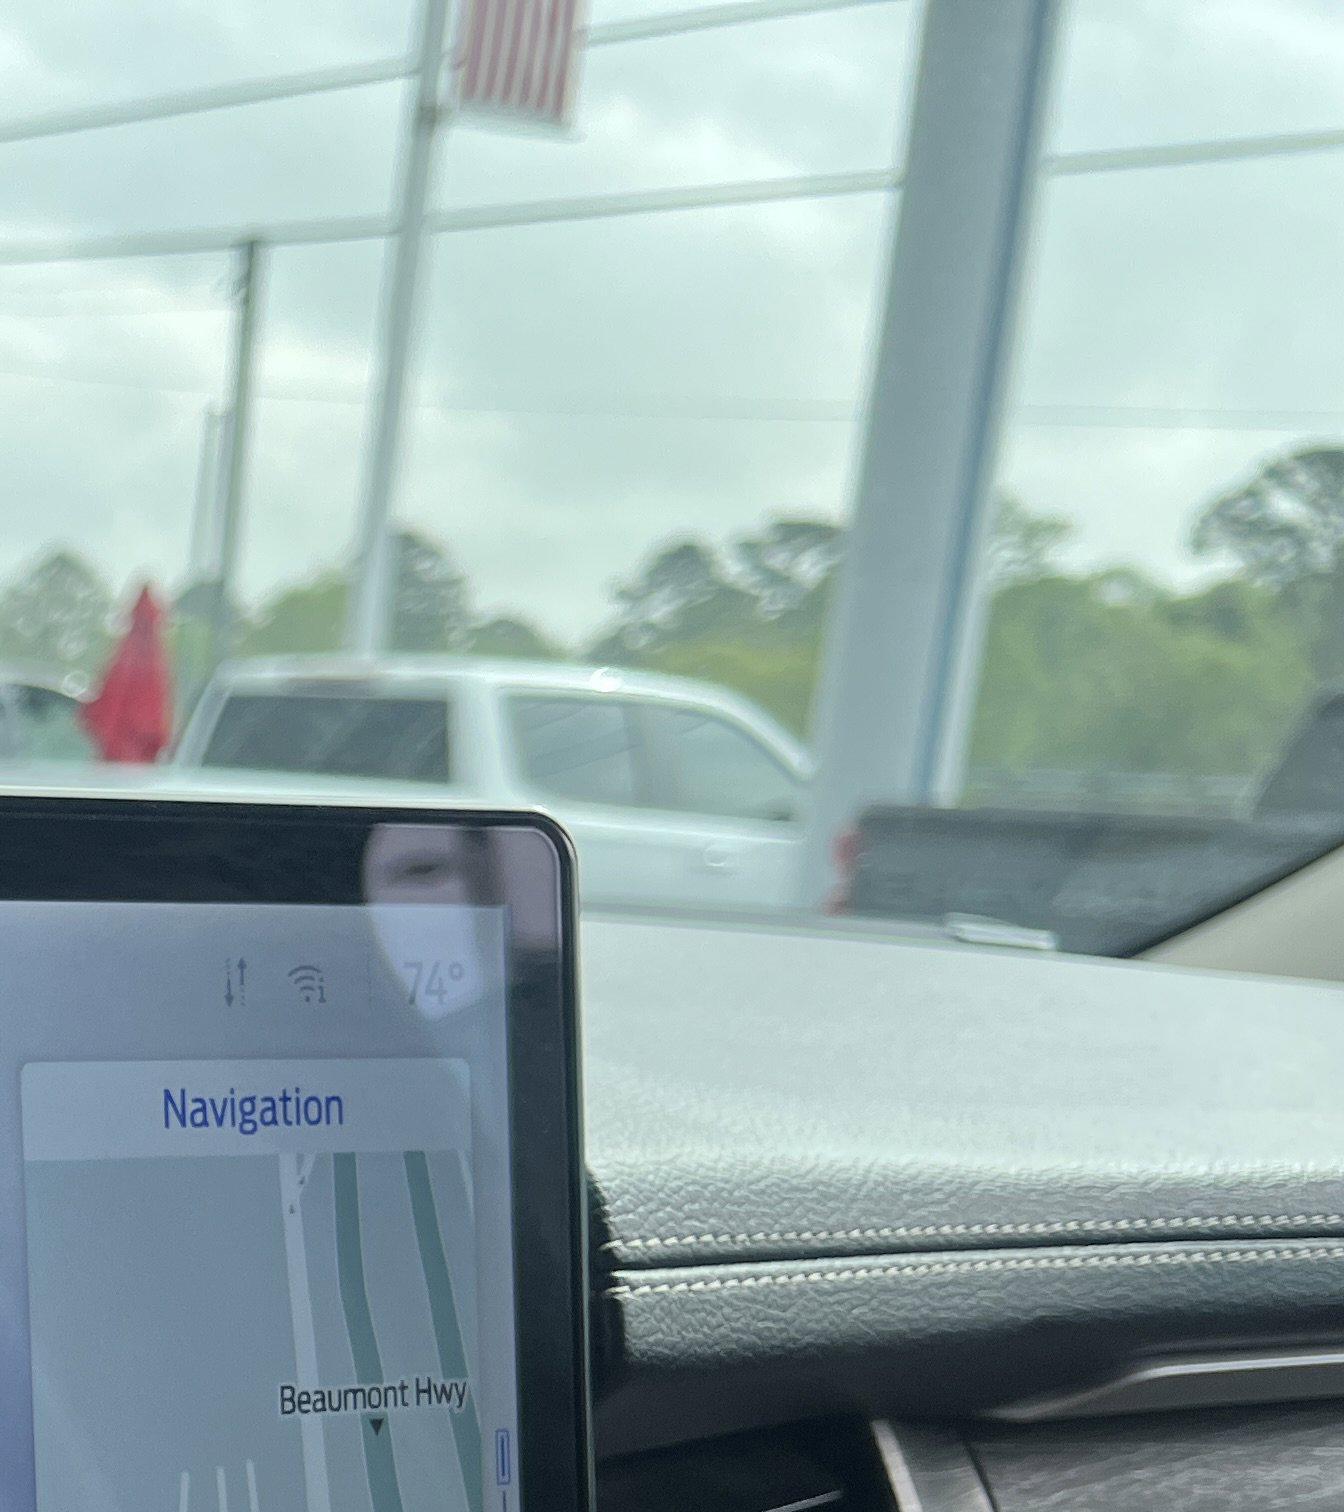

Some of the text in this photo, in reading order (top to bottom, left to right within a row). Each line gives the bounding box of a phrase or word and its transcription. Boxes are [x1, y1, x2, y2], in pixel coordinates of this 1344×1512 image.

[162, 1086, 345, 1136] Navigation
[279, 1375, 468, 1416] Beaumont Hwy
